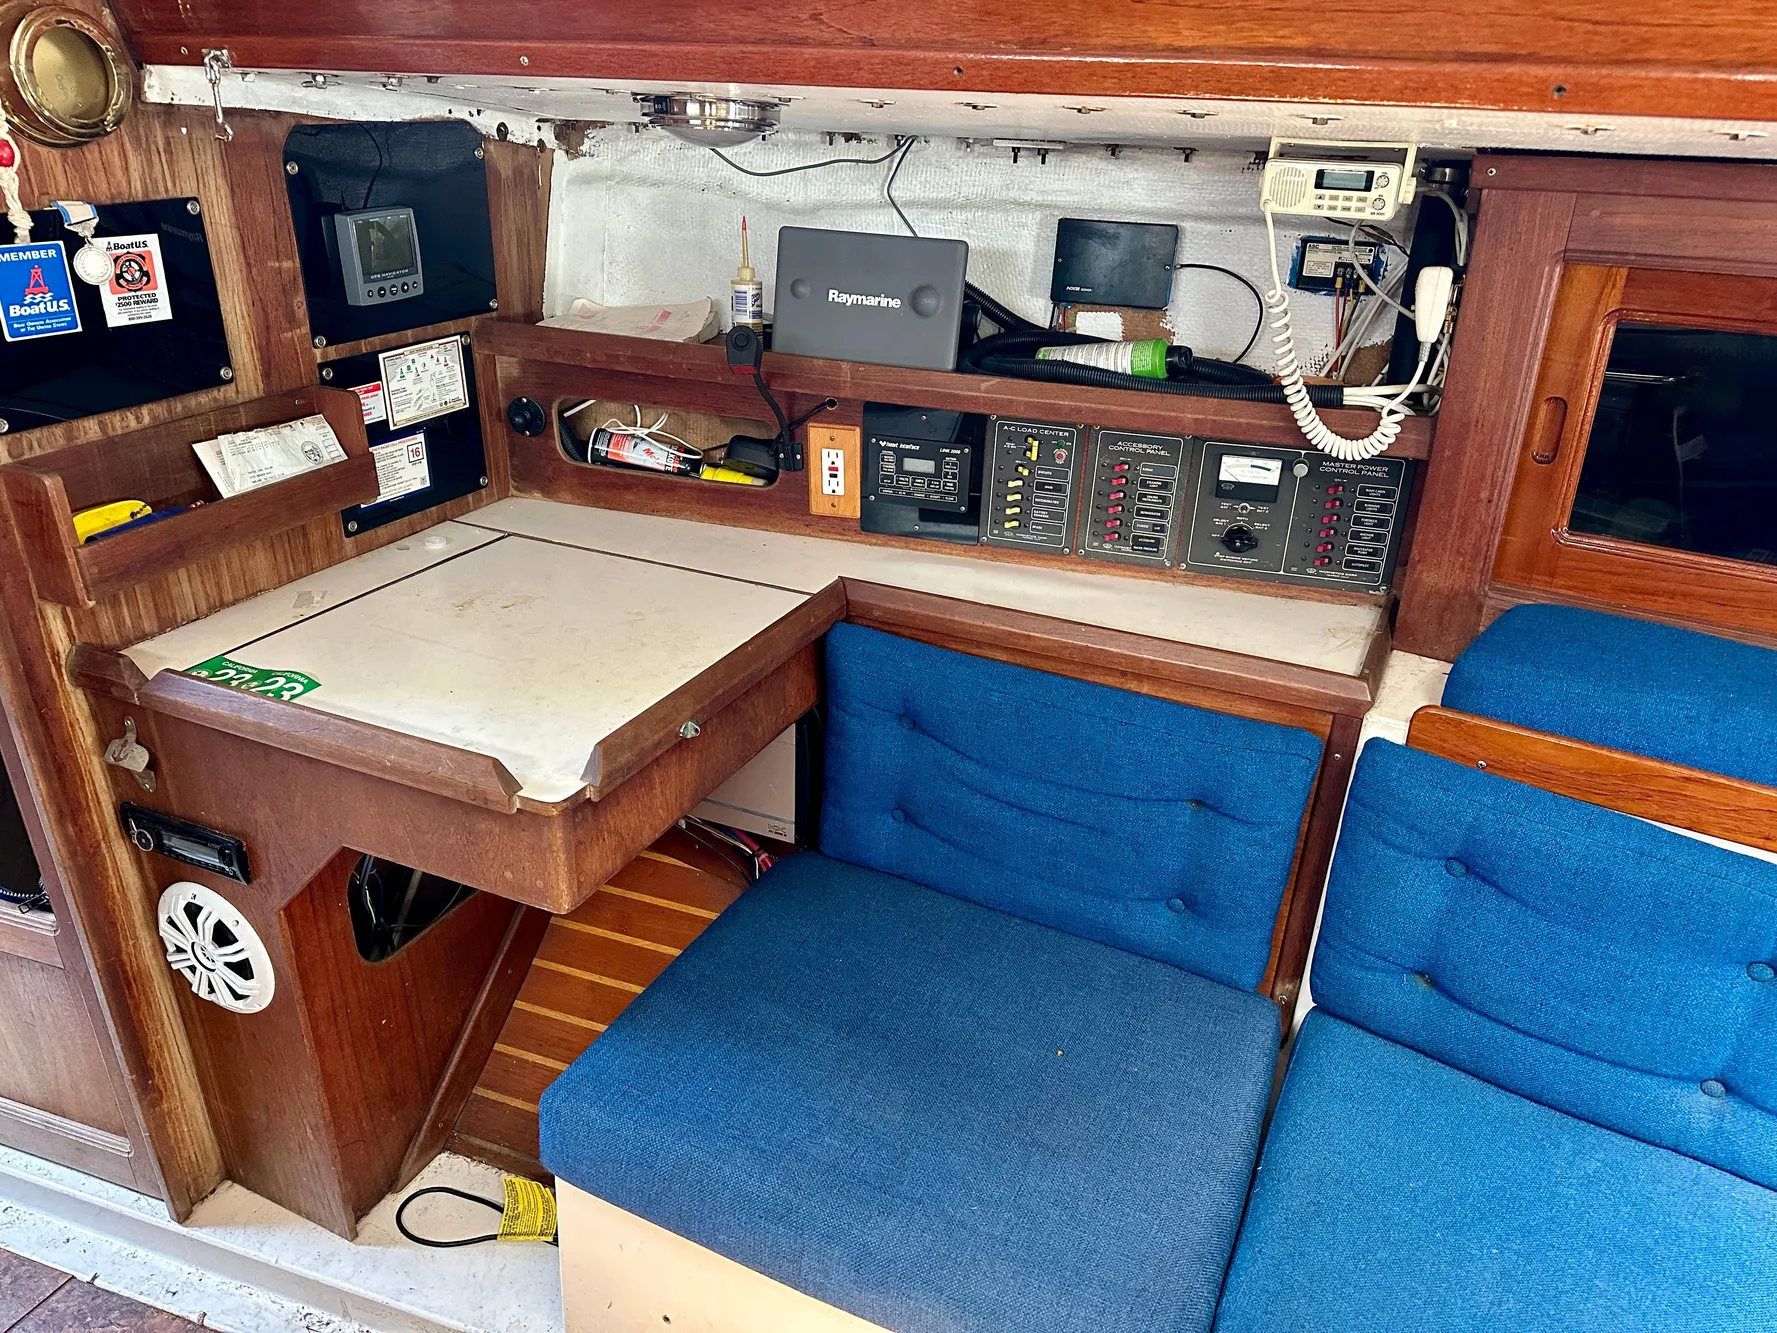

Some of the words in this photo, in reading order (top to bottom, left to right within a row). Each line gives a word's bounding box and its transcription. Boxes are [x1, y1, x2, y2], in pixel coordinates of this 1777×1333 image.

[0, 249, 57, 262] MEMBER
[117, 293, 156, 301] PROTECTED
[828, 289, 901, 308] Raymarine
[133, 298, 158, 306] REWARD
[1108, 446, 1145, 454] CONTROL
[1117, 441, 1163, 450] ACCESSORY
[410, 447, 420, 458] 16
[1322, 461, 1356, 469] MASTER
[222, 661, 258, 674] CALIFORNIA
